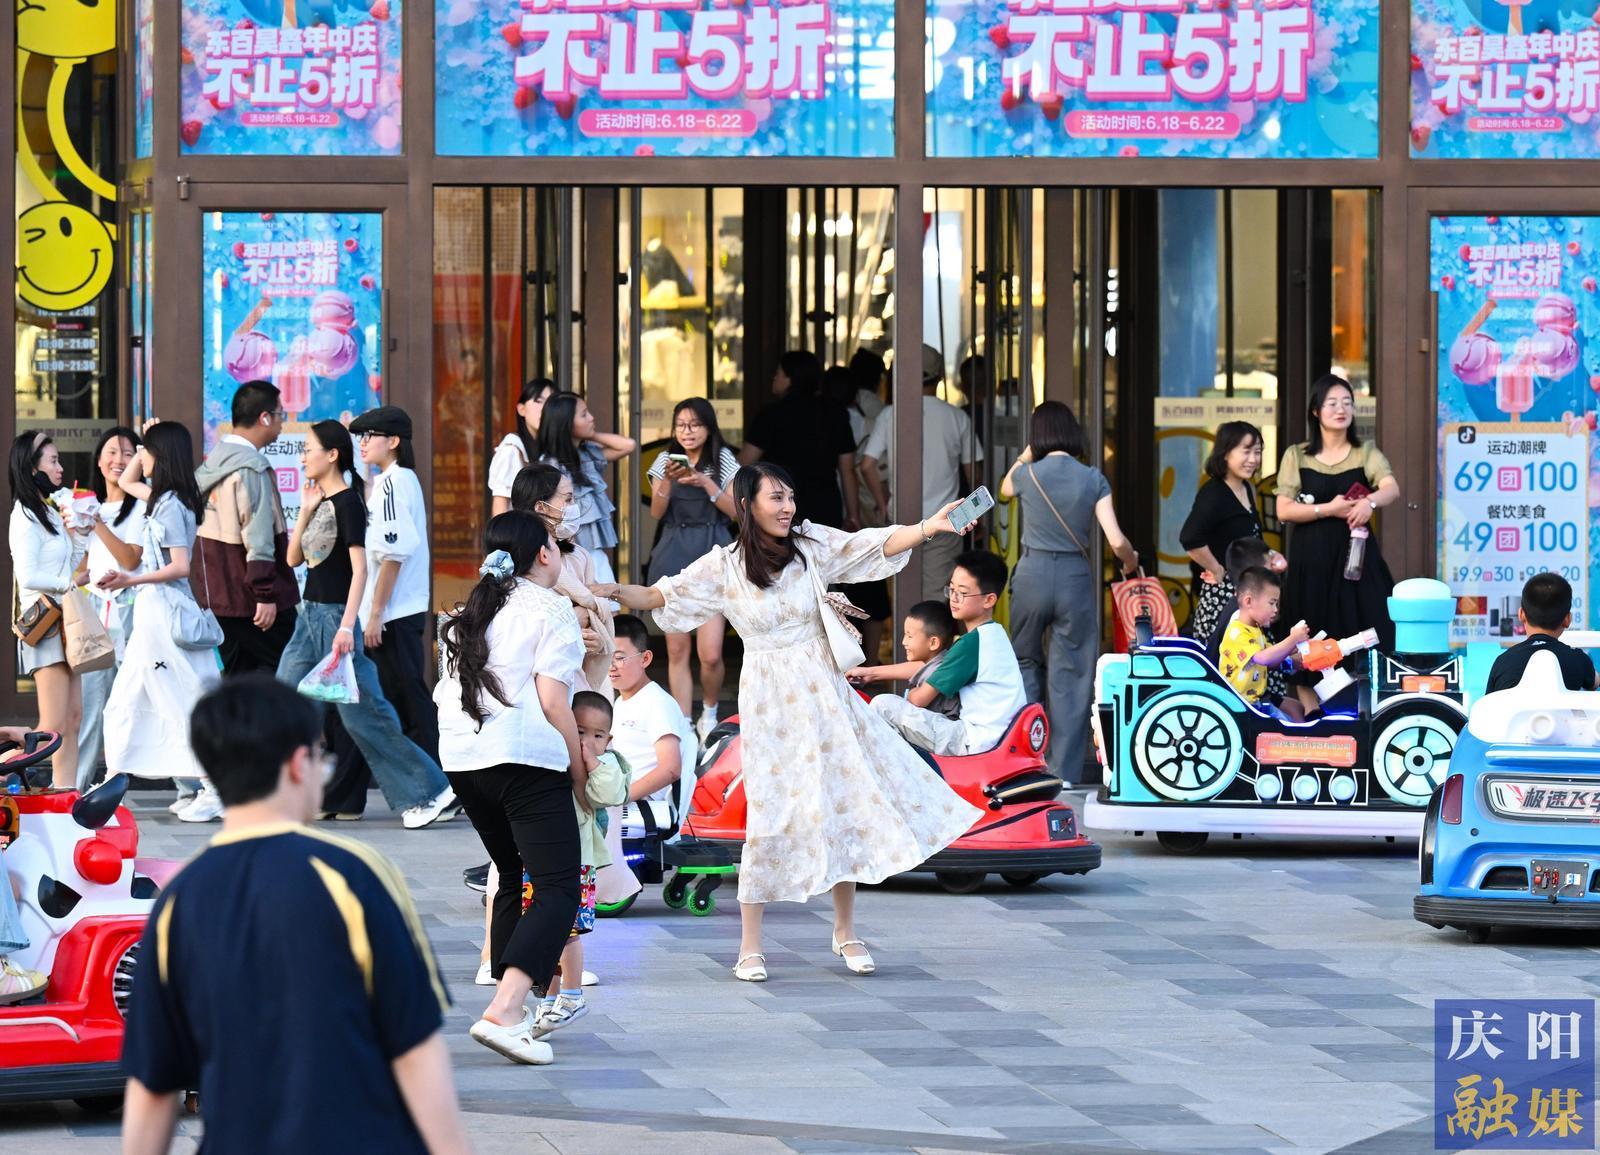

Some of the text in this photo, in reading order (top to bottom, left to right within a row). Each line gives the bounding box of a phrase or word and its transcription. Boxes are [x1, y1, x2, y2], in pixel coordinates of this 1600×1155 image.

[514, 4, 830, 97] 不止5折
[1001, 8, 1312, 98] 不止5折
[203, 55, 378, 106] 不止5折
[1431, 60, 1600, 110] 不止5折
[242, 256, 338, 284] 不止5折
[1468, 258, 1561, 287] 不止5折
[1487, 440, 1547, 455] 运动潮牌
[1487, 505, 1547, 519] 餐饮美食
